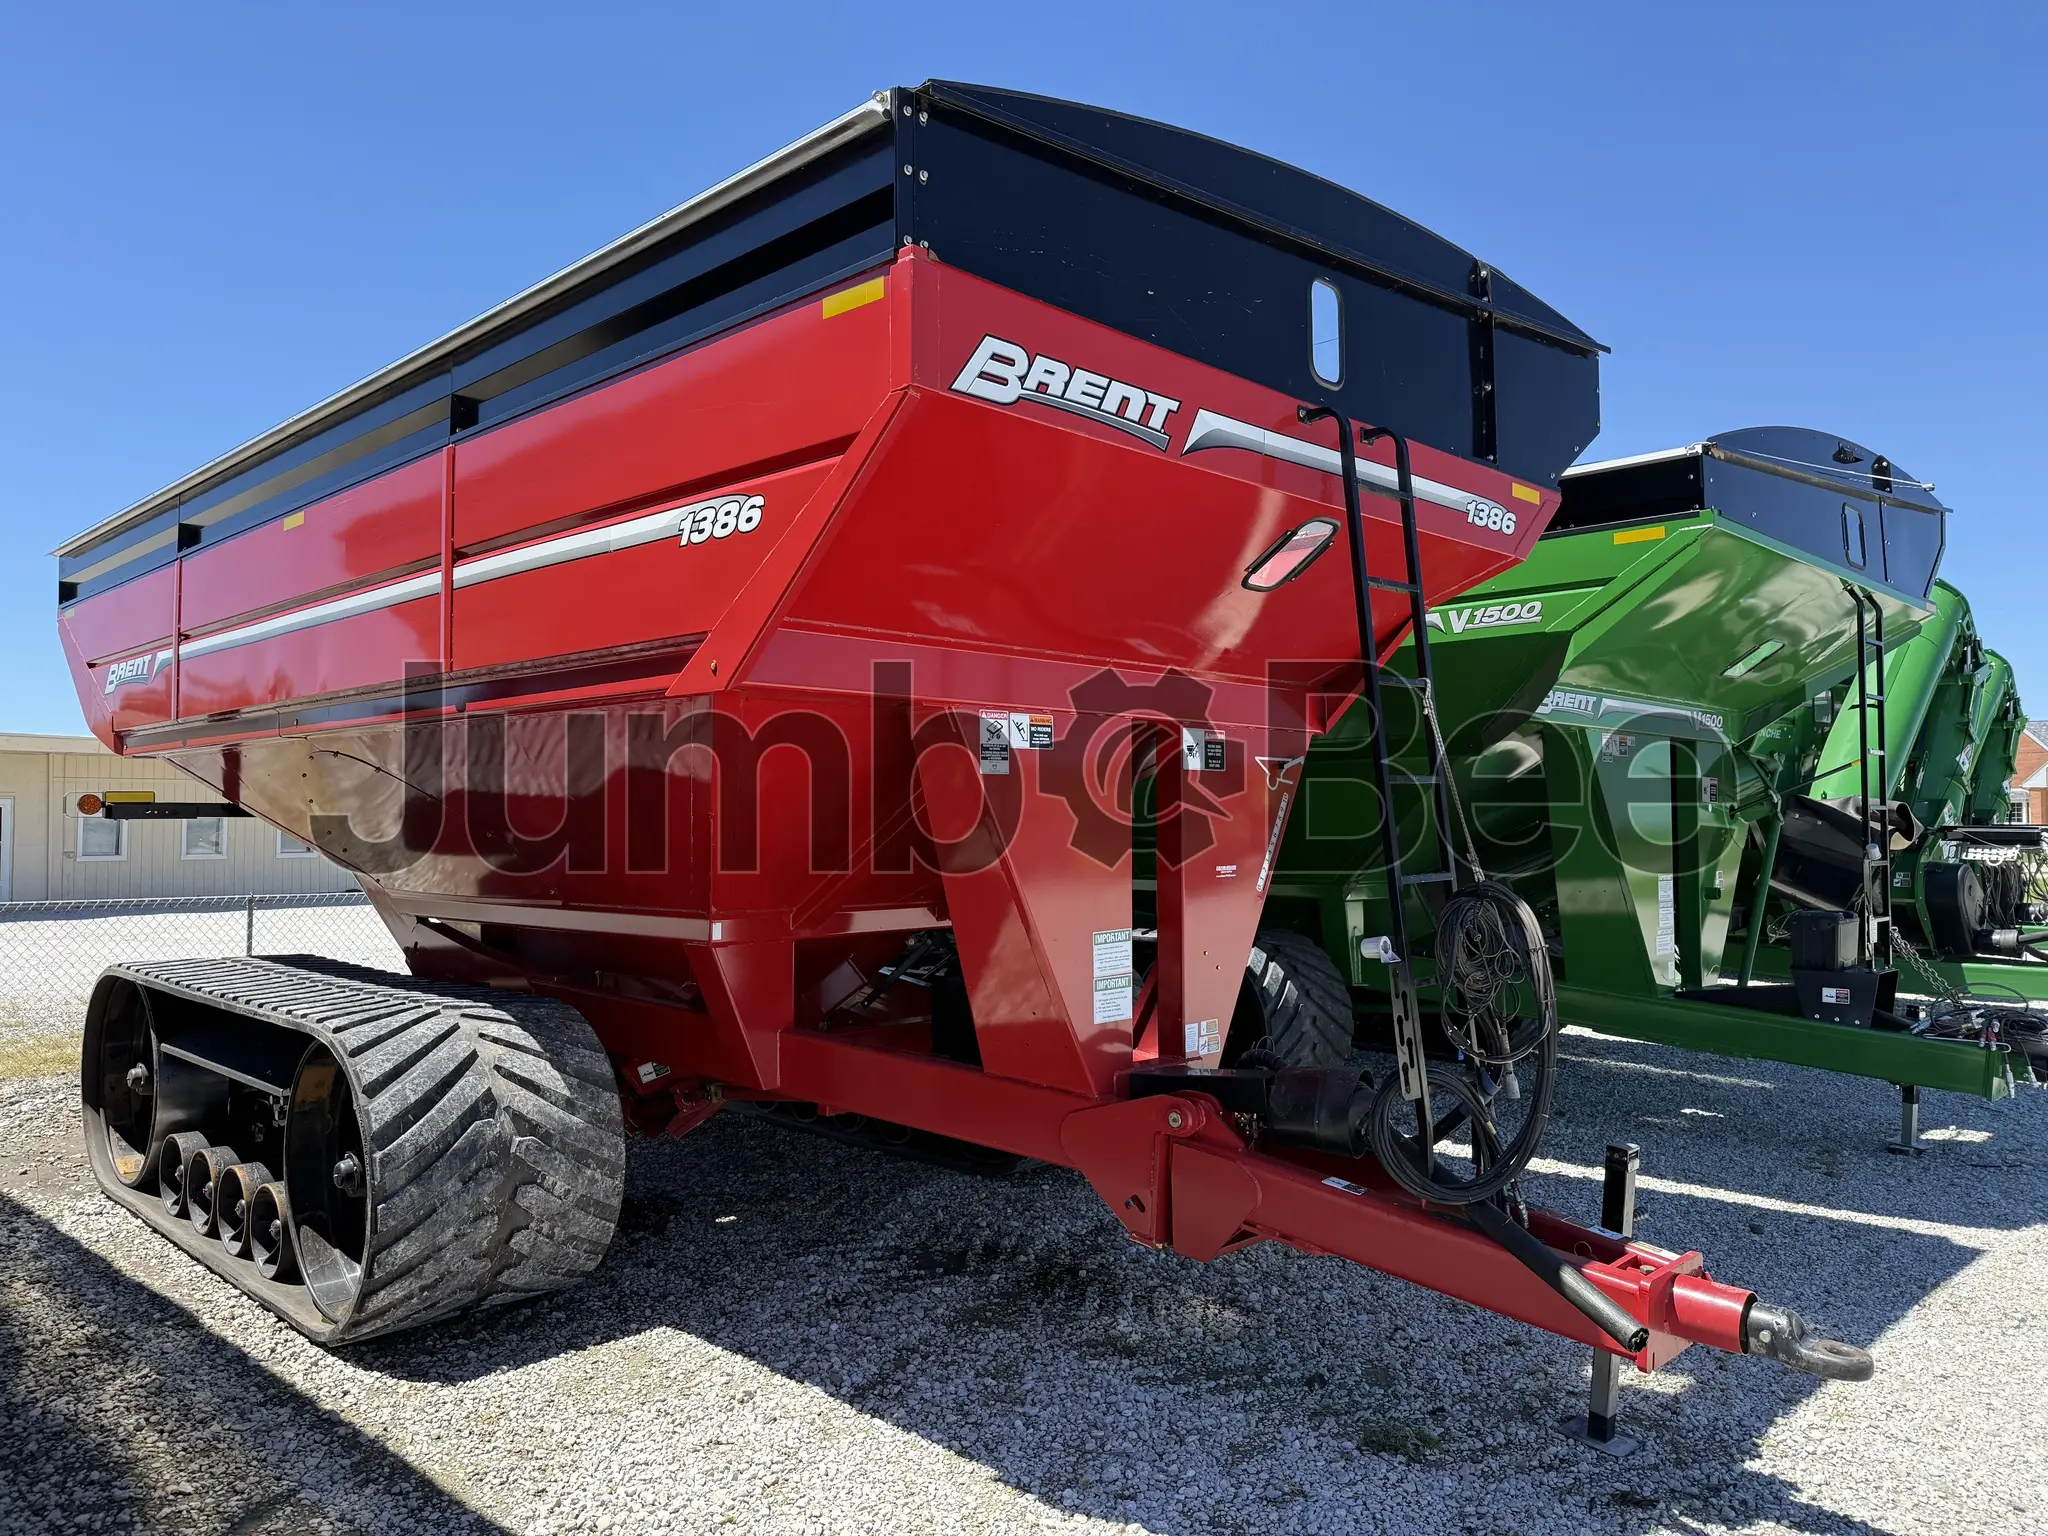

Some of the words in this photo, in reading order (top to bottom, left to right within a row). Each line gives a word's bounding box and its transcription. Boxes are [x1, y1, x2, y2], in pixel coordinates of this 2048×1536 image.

[949, 333, 1183, 436] BRENT
[678, 494, 765, 548] 1386
[1466, 500, 1517, 536] 1386
[1448, 601, 1542, 634] V1500
[104, 653, 153, 695] BRENT
[1095, 931, 1130, 944] IMPORTANT
[1096, 977, 1129, 990] IMPORTANT
